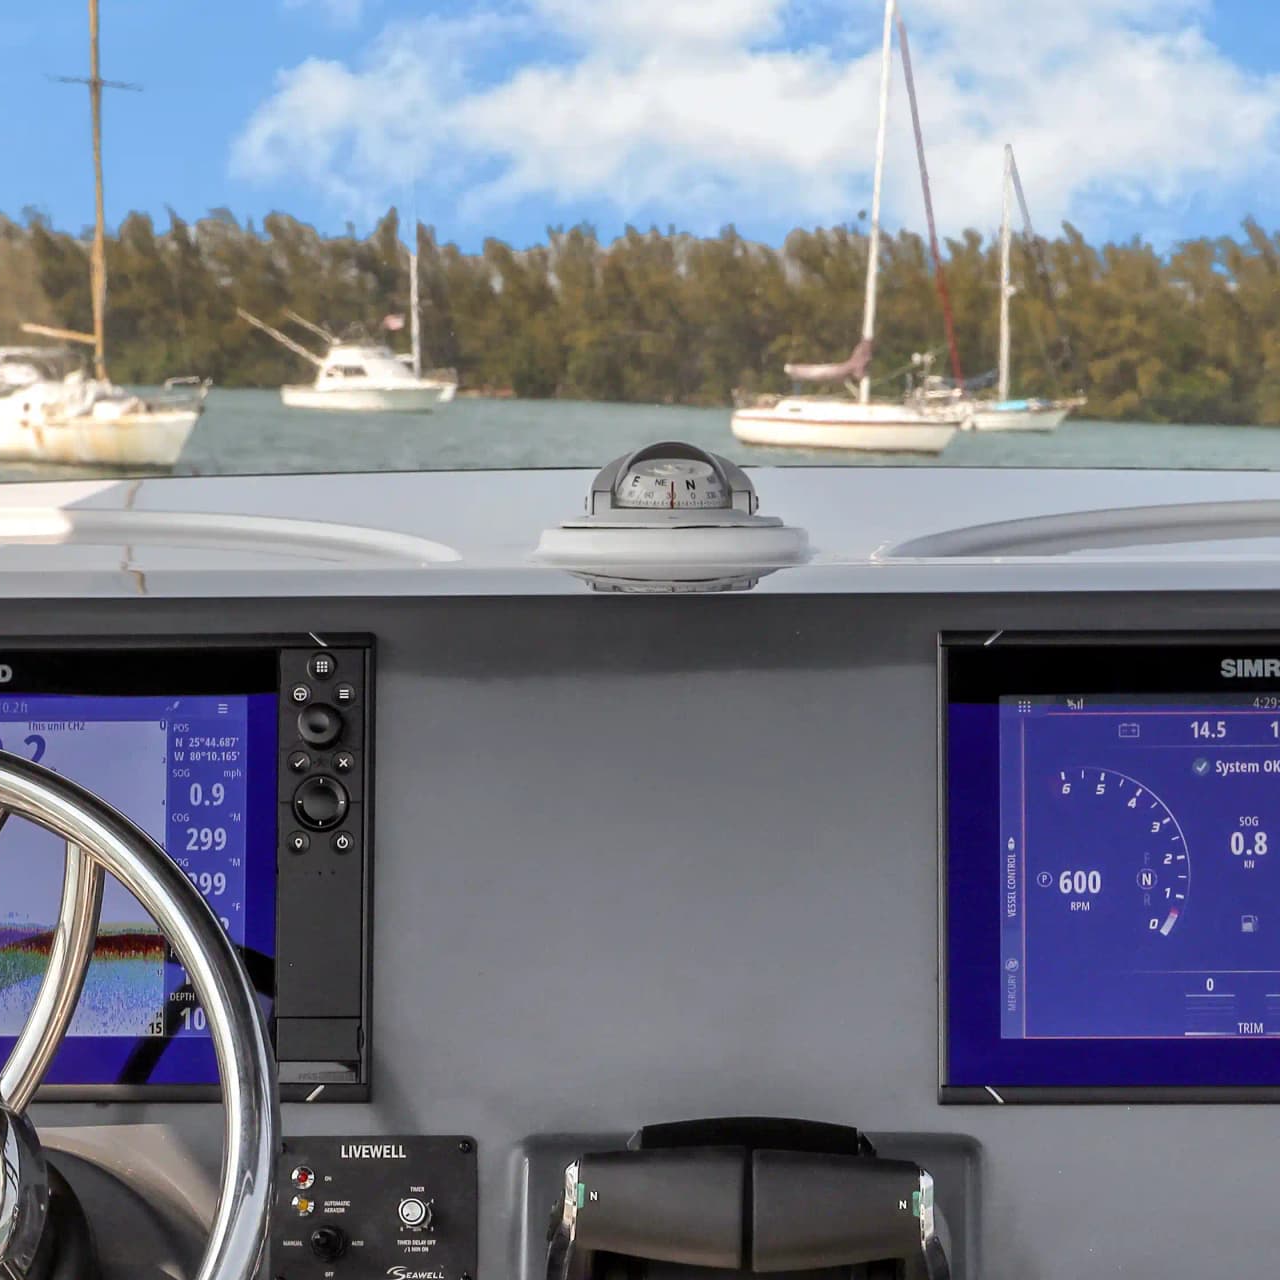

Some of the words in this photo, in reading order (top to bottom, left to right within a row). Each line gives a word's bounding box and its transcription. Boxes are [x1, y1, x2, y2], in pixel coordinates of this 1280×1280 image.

[654, 479, 668, 487] NE
[685, 479, 696, 490] N
[172, 723, 190, 733] POS
[1190, 720, 1227, 738] 14.5
[175, 738, 183, 748] N
[174, 751, 185, 761] W
[1215, 759, 1260, 775] System
[172, 768, 191, 778] SOG
[223, 769, 242, 780] mph
[1061, 783, 1072, 794] 6
[1095, 783, 1106, 795] 5
[189, 783, 225, 806] 0.9
[1127, 797, 1138, 808] 4
[171, 812, 190, 822] COG
[1239, 816, 1259, 826] SOG
[1150, 821, 1161, 833] 3
[185, 827, 227, 851] 299
[1230, 831, 1268, 855] 0.8
[1163, 853, 1173, 864] 2
[1244, 860, 1255, 869] KN
[1007, 854, 1017, 891] CONTROL
[1058, 870, 1101, 894] 600
[1164, 887, 1172, 898] 1
[1007, 892, 1017, 918] VESSEL
[1070, 901, 1090, 912] RPM
[1149, 918, 1159, 930] 0
[1206, 977, 1214, 991] 0
[170, 992, 195, 1001] DEPTH
[1007, 975, 1017, 1011] MERCURY
[148, 1022, 162, 1034] 15
[1237, 1022, 1264, 1035] TRIM
[340, 1144, 407, 1159] LIVEWELL
[590, 1191, 598, 1201] N
[899, 1199, 907, 1210] N
